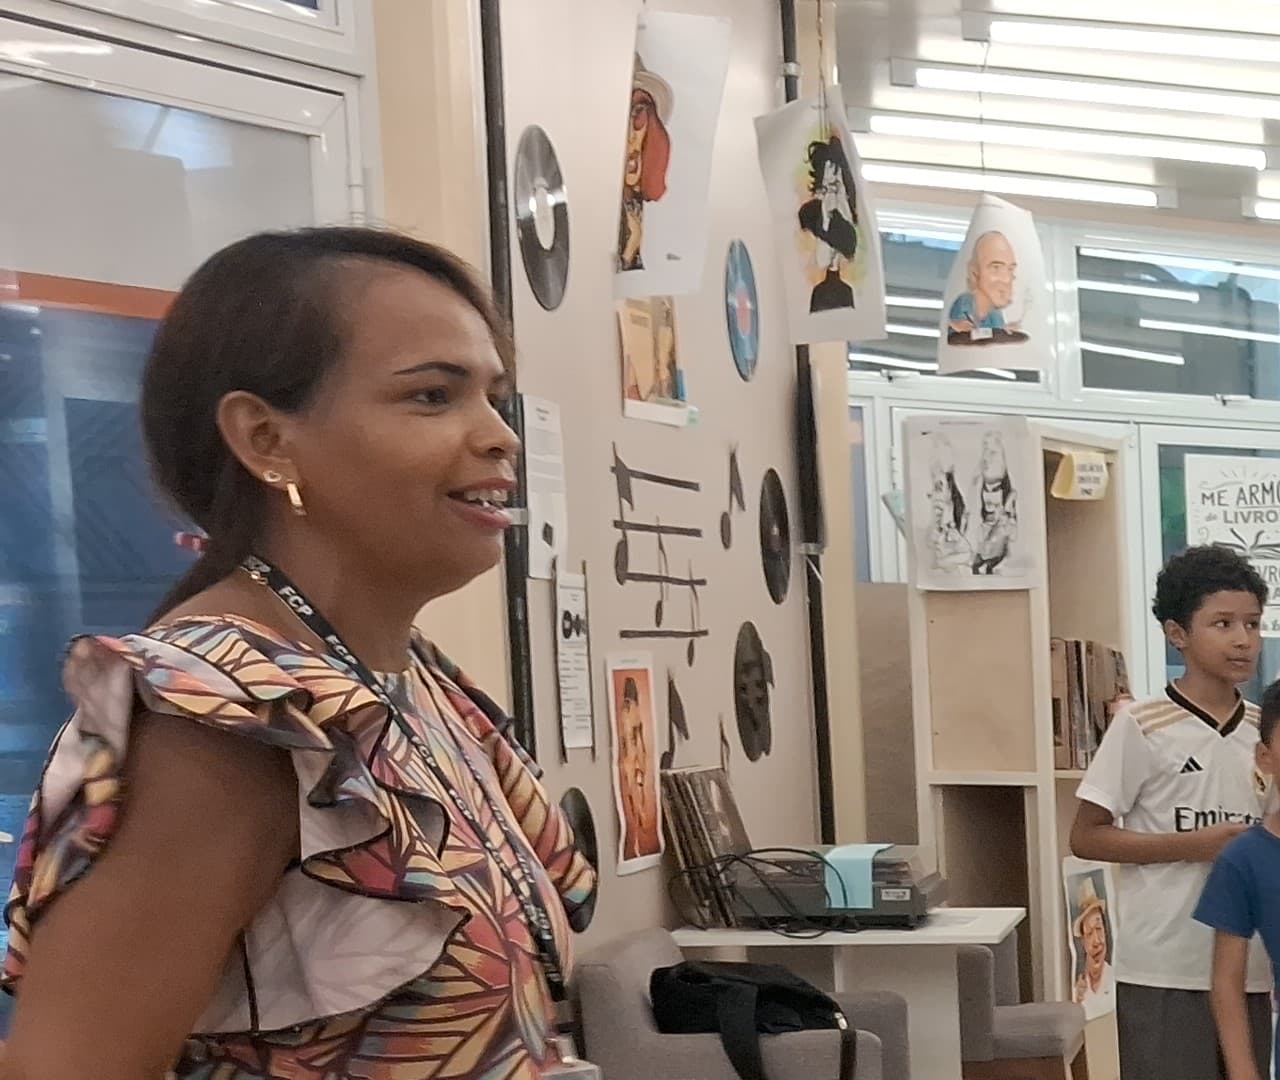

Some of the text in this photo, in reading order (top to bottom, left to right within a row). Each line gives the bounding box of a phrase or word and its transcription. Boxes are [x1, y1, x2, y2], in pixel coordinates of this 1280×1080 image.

[1202, 490, 1228, 506] ME
[279, 586, 313, 616] FCP
[325, 634, 358, 665] FCP
